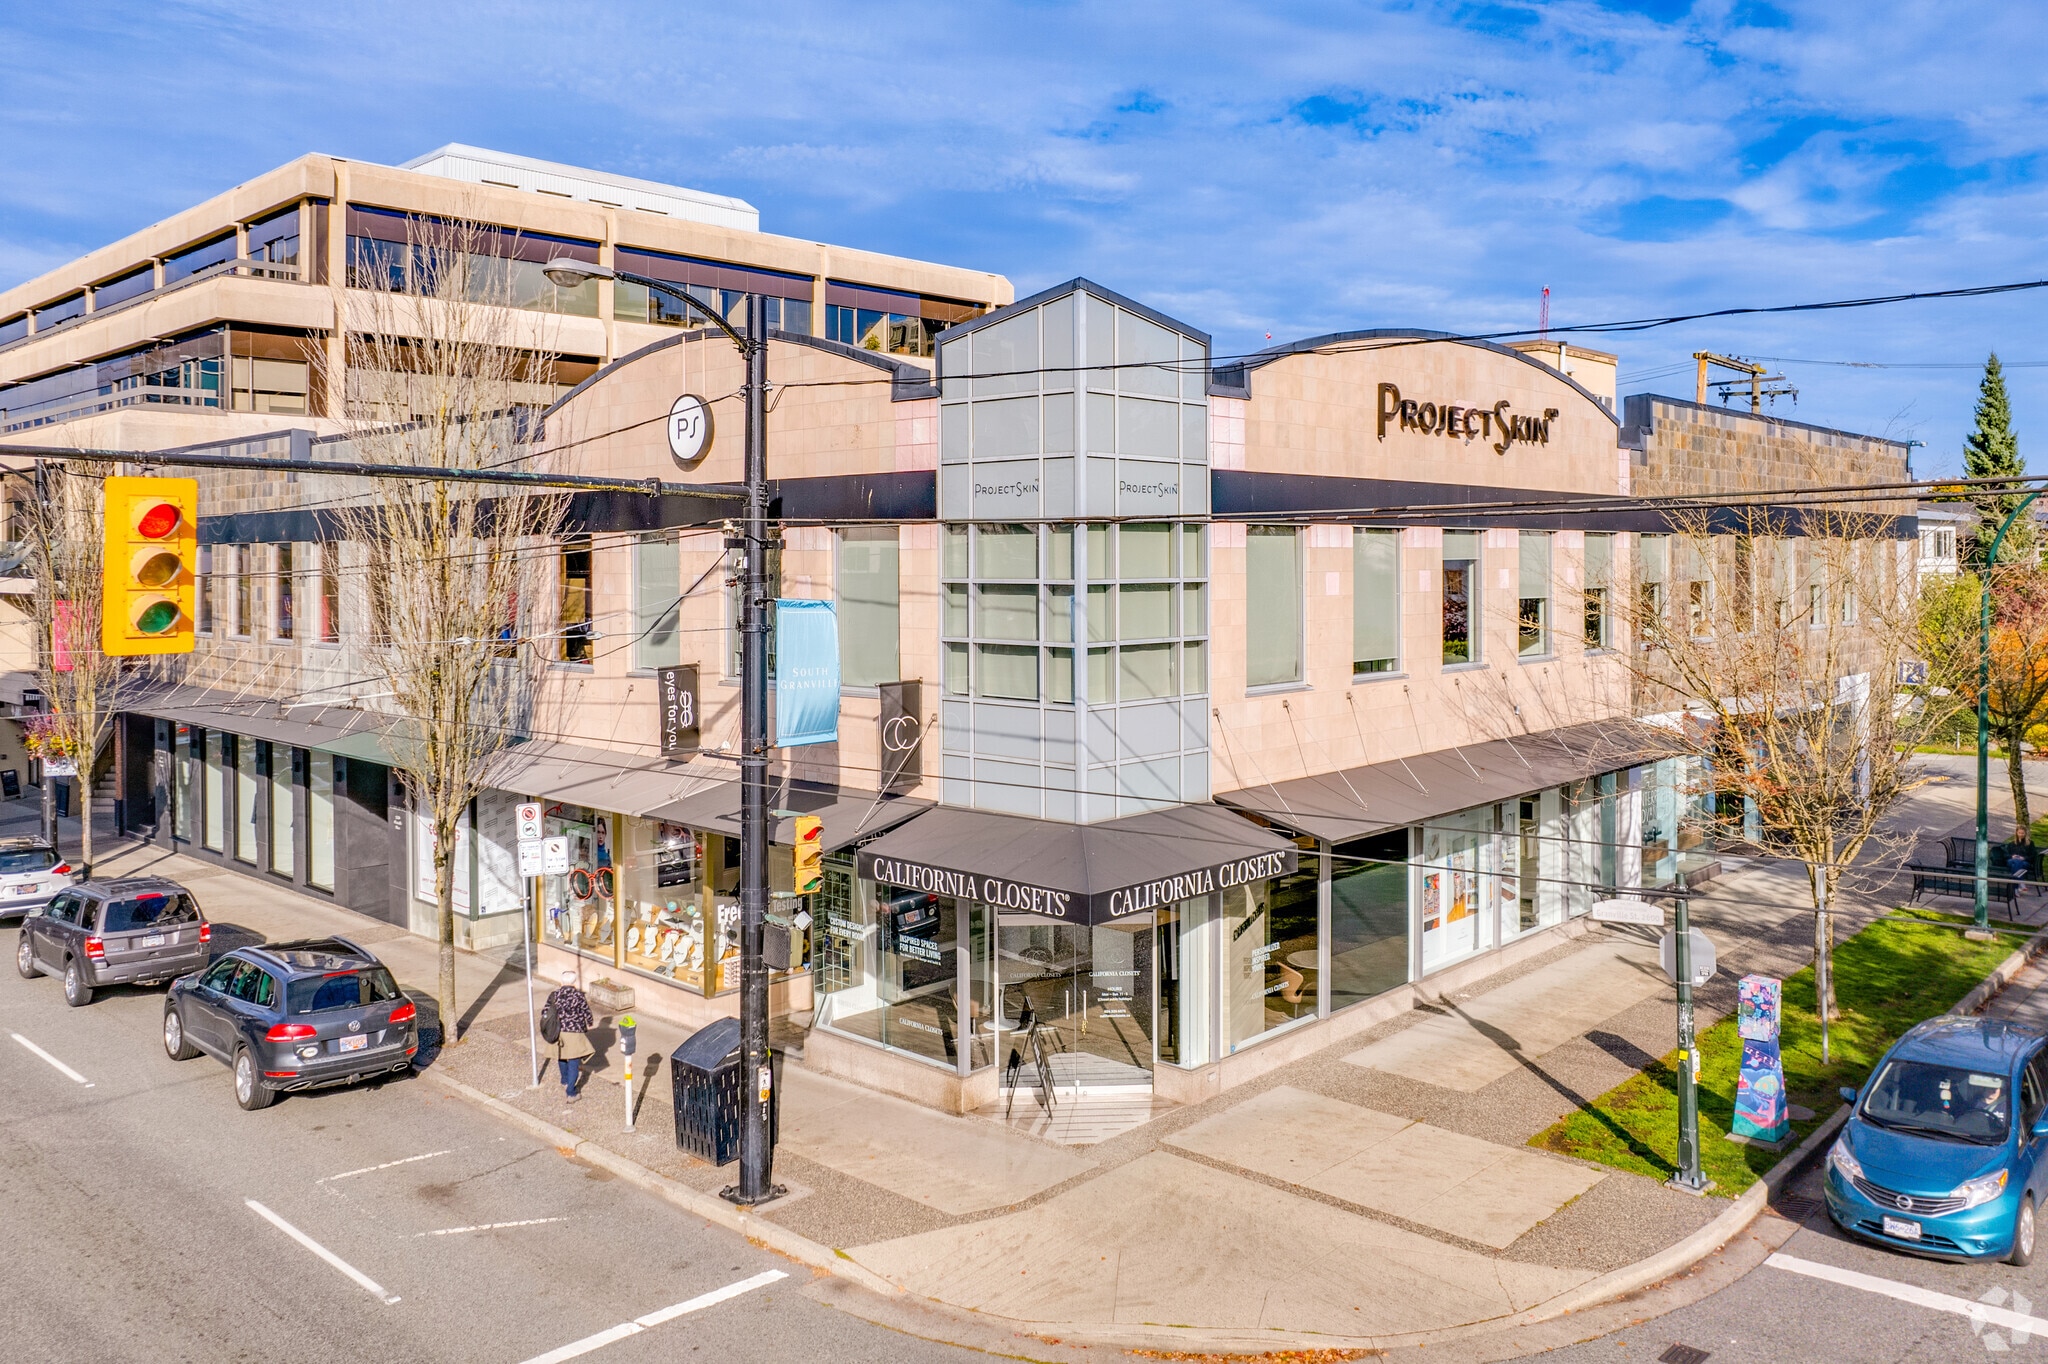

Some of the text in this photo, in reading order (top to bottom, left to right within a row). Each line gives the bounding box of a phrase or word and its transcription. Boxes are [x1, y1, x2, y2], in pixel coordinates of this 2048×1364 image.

[677, 415, 699, 440] PS
[792, 667, 829, 678] SOUTH
[664, 671, 679, 751] eyes for you
[873, 857, 979, 900] CALIFORNIA
[1109, 869, 1214, 917] CALIFORNIA
[773, 896, 803, 912] Testing
[899, 934, 938, 951] INSPIRED SPACES
[899, 942, 909, 952] FOR
[909, 944, 926, 957] BETTER
[926, 949, 941, 961] LIVING
[899, 1017, 943, 1036] CALIFORNIA CLOSETS
